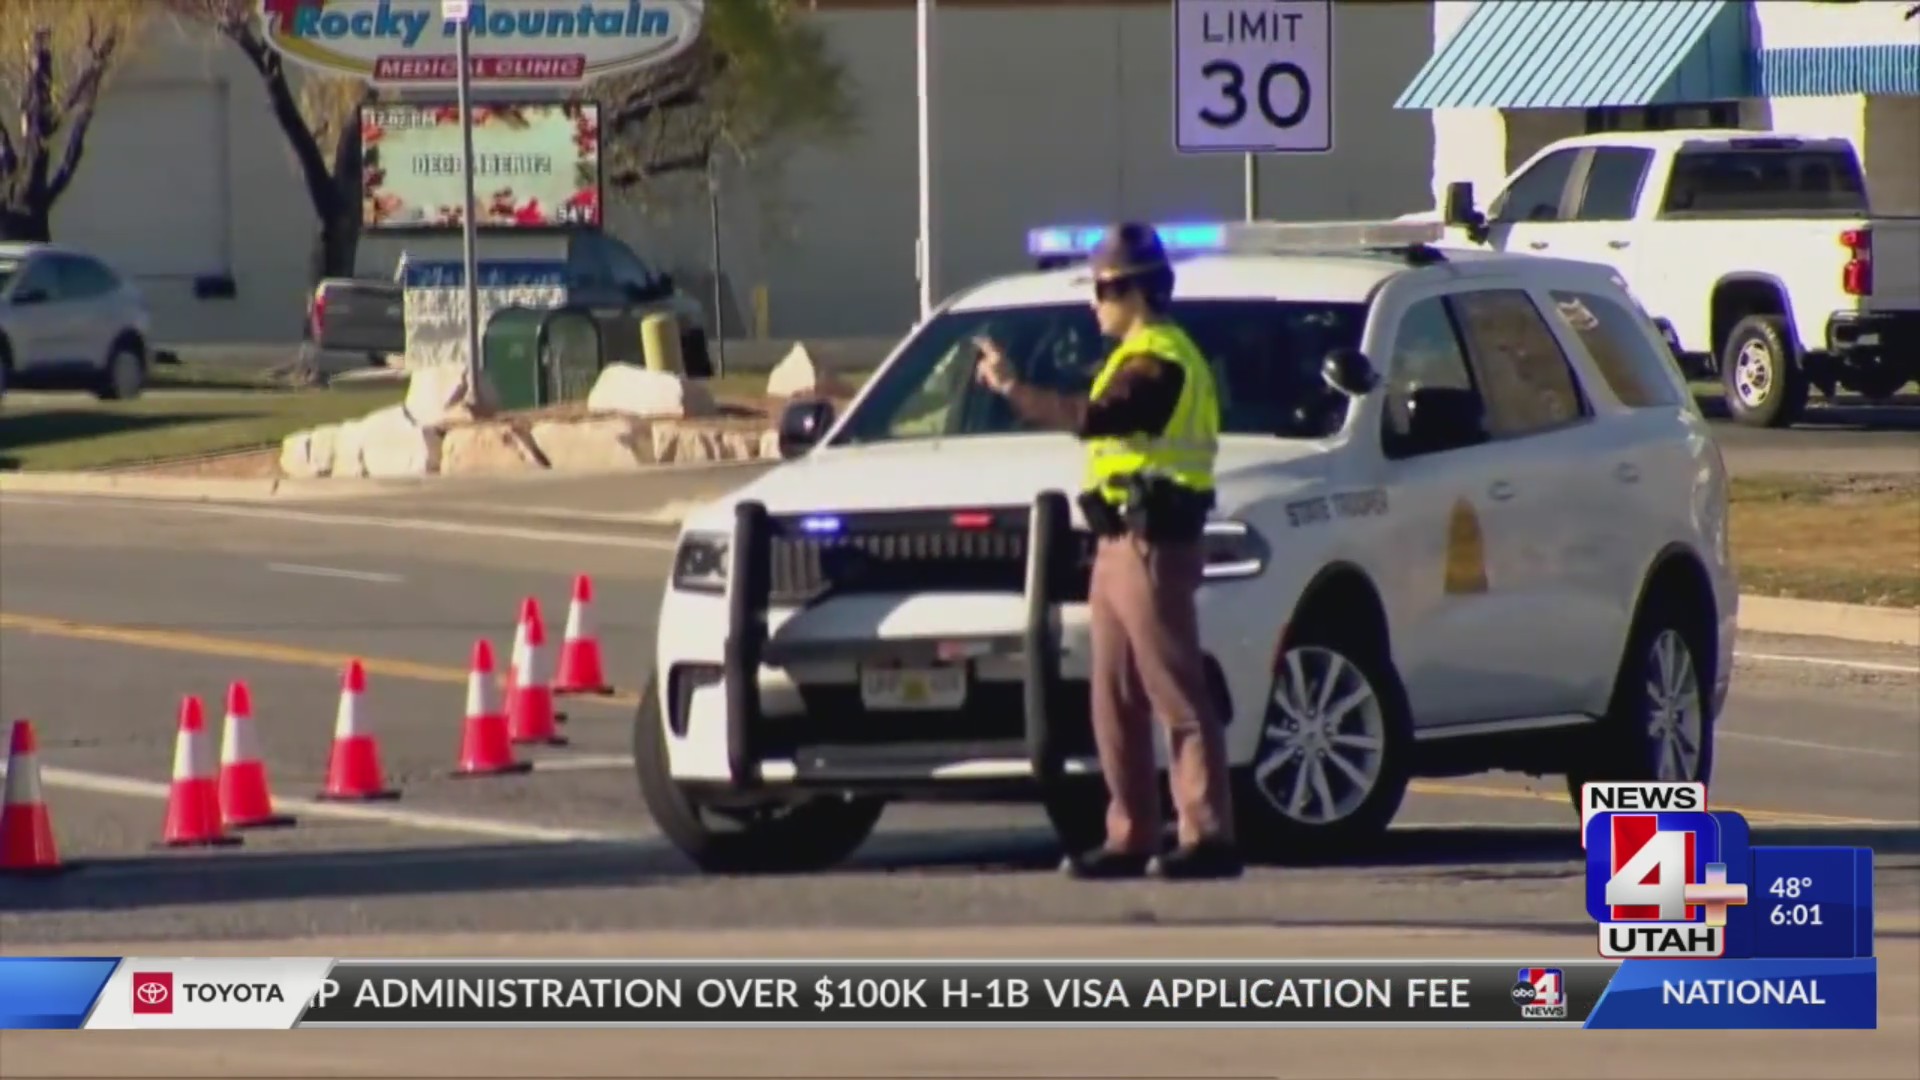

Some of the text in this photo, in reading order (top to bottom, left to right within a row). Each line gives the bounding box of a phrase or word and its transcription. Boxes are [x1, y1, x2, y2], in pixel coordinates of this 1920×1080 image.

[293, 0, 429, 48] Rocky
[1203, 11, 1303, 42] LIMIT
[495, 60, 579, 76] CLINIC
[1199, 60, 1311, 128] 30
[1286, 497, 1331, 527] STATE
